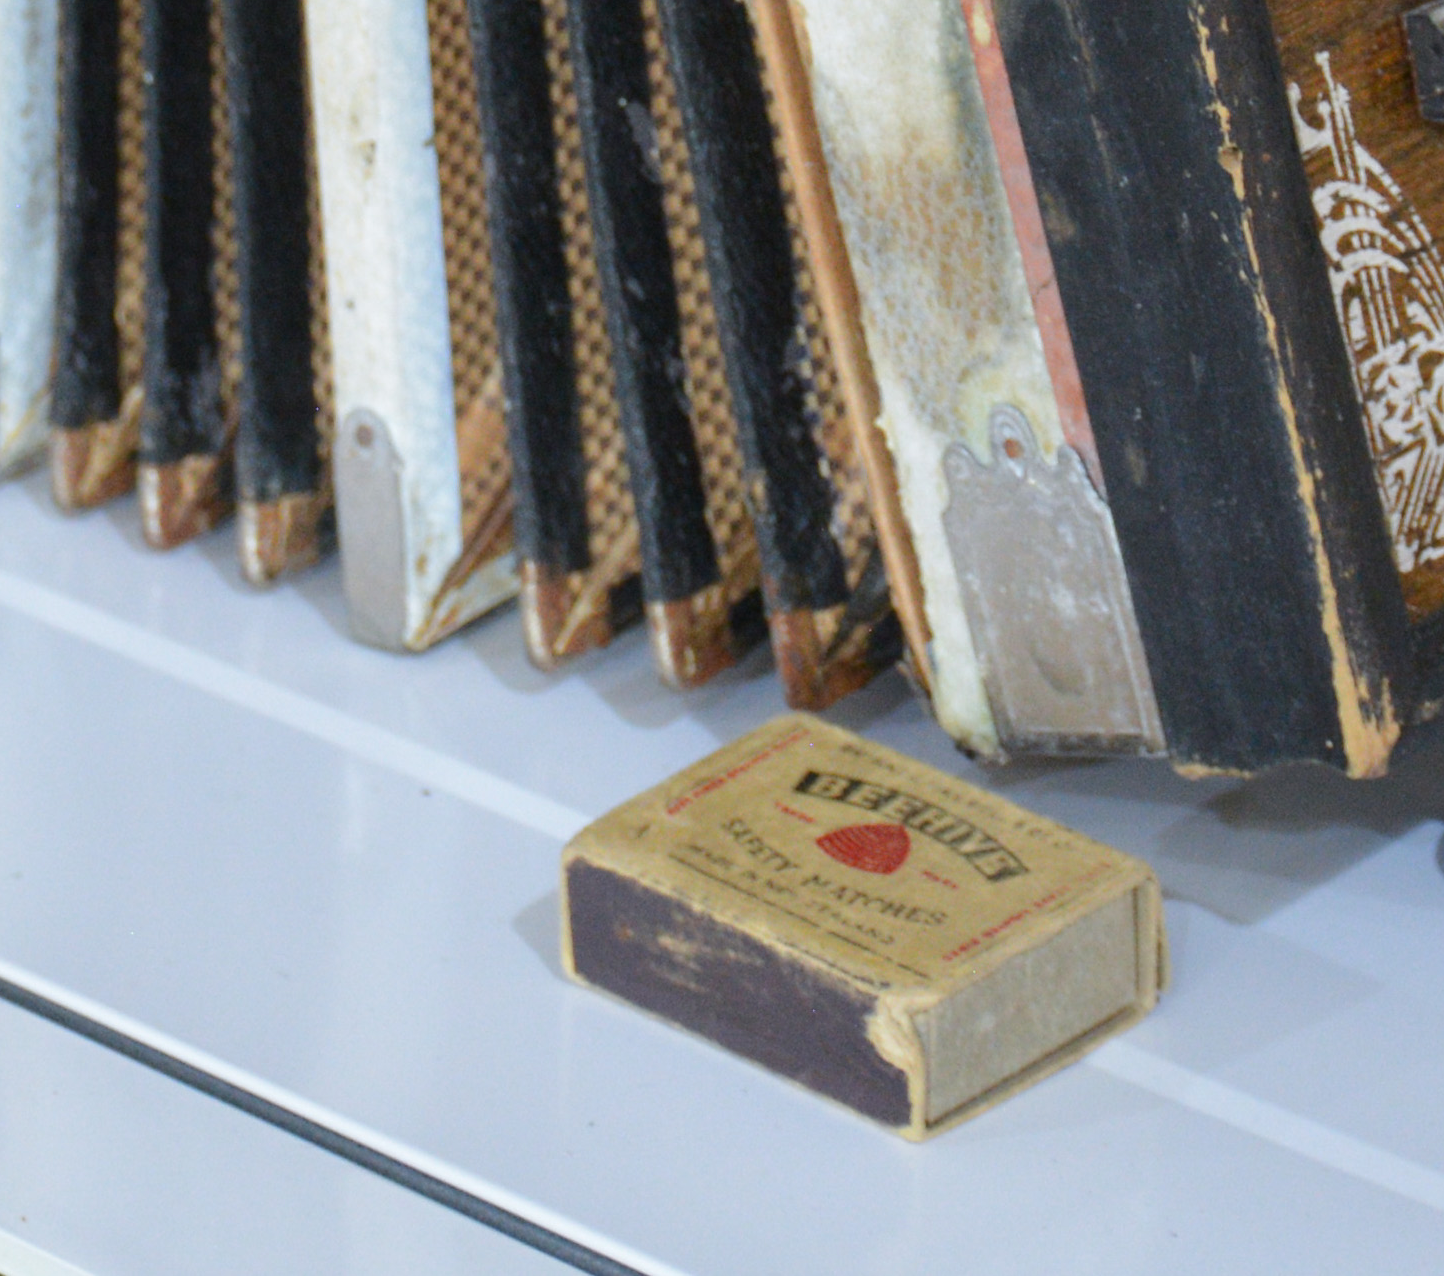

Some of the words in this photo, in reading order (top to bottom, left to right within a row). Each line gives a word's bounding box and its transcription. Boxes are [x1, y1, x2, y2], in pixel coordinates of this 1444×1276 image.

[720, 816, 800, 873] SAFETY
[801, 874, 949, 926] MATCHES
[805, 771, 1019, 879] BEEHIVE
